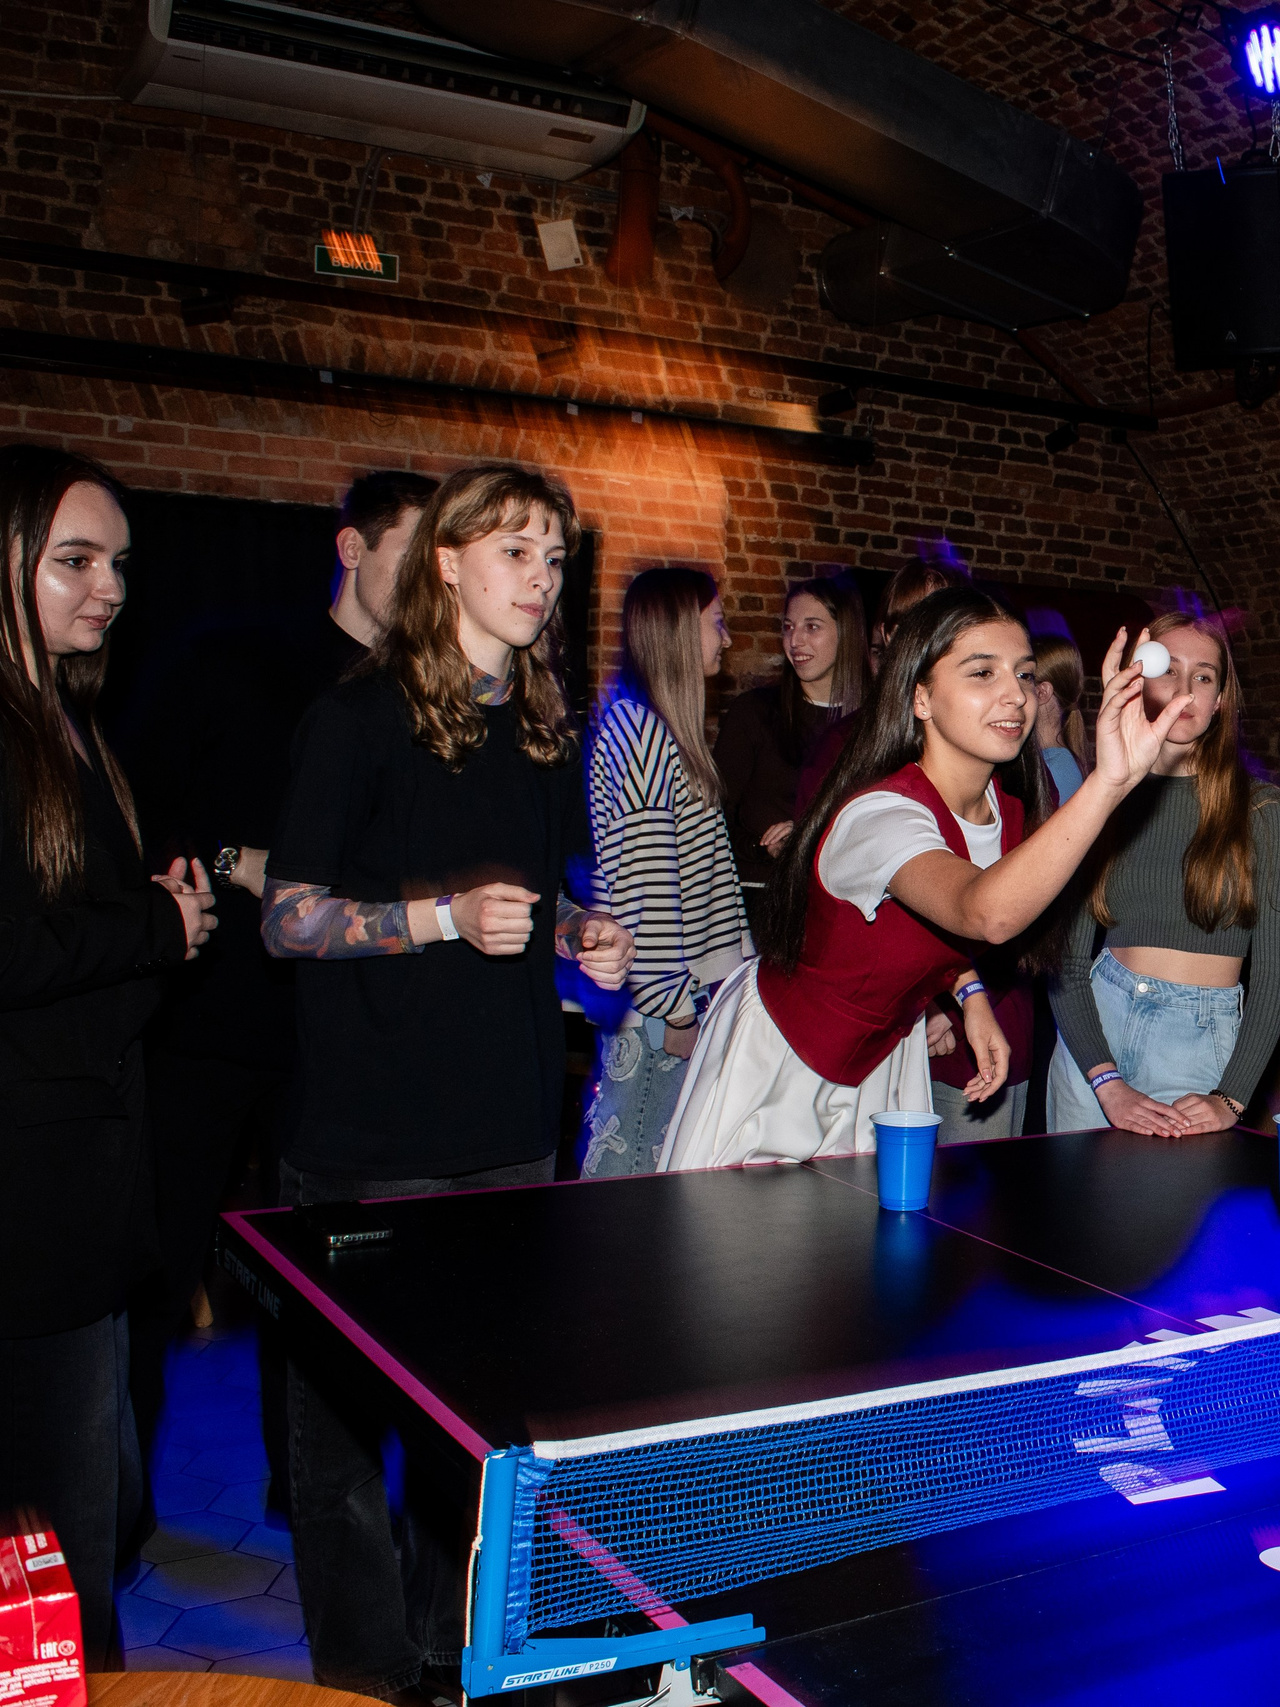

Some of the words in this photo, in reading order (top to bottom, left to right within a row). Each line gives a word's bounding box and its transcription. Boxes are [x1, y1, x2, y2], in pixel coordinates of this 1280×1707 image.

[331, 255, 384, 275] ВЫХОД
[224, 1248, 258, 1296] START
[257, 1281, 281, 1320] LINE
[505, 1671, 551, 1686] START
[554, 1665, 581, 1677] LINE
[589, 1660, 611, 1671] P250
